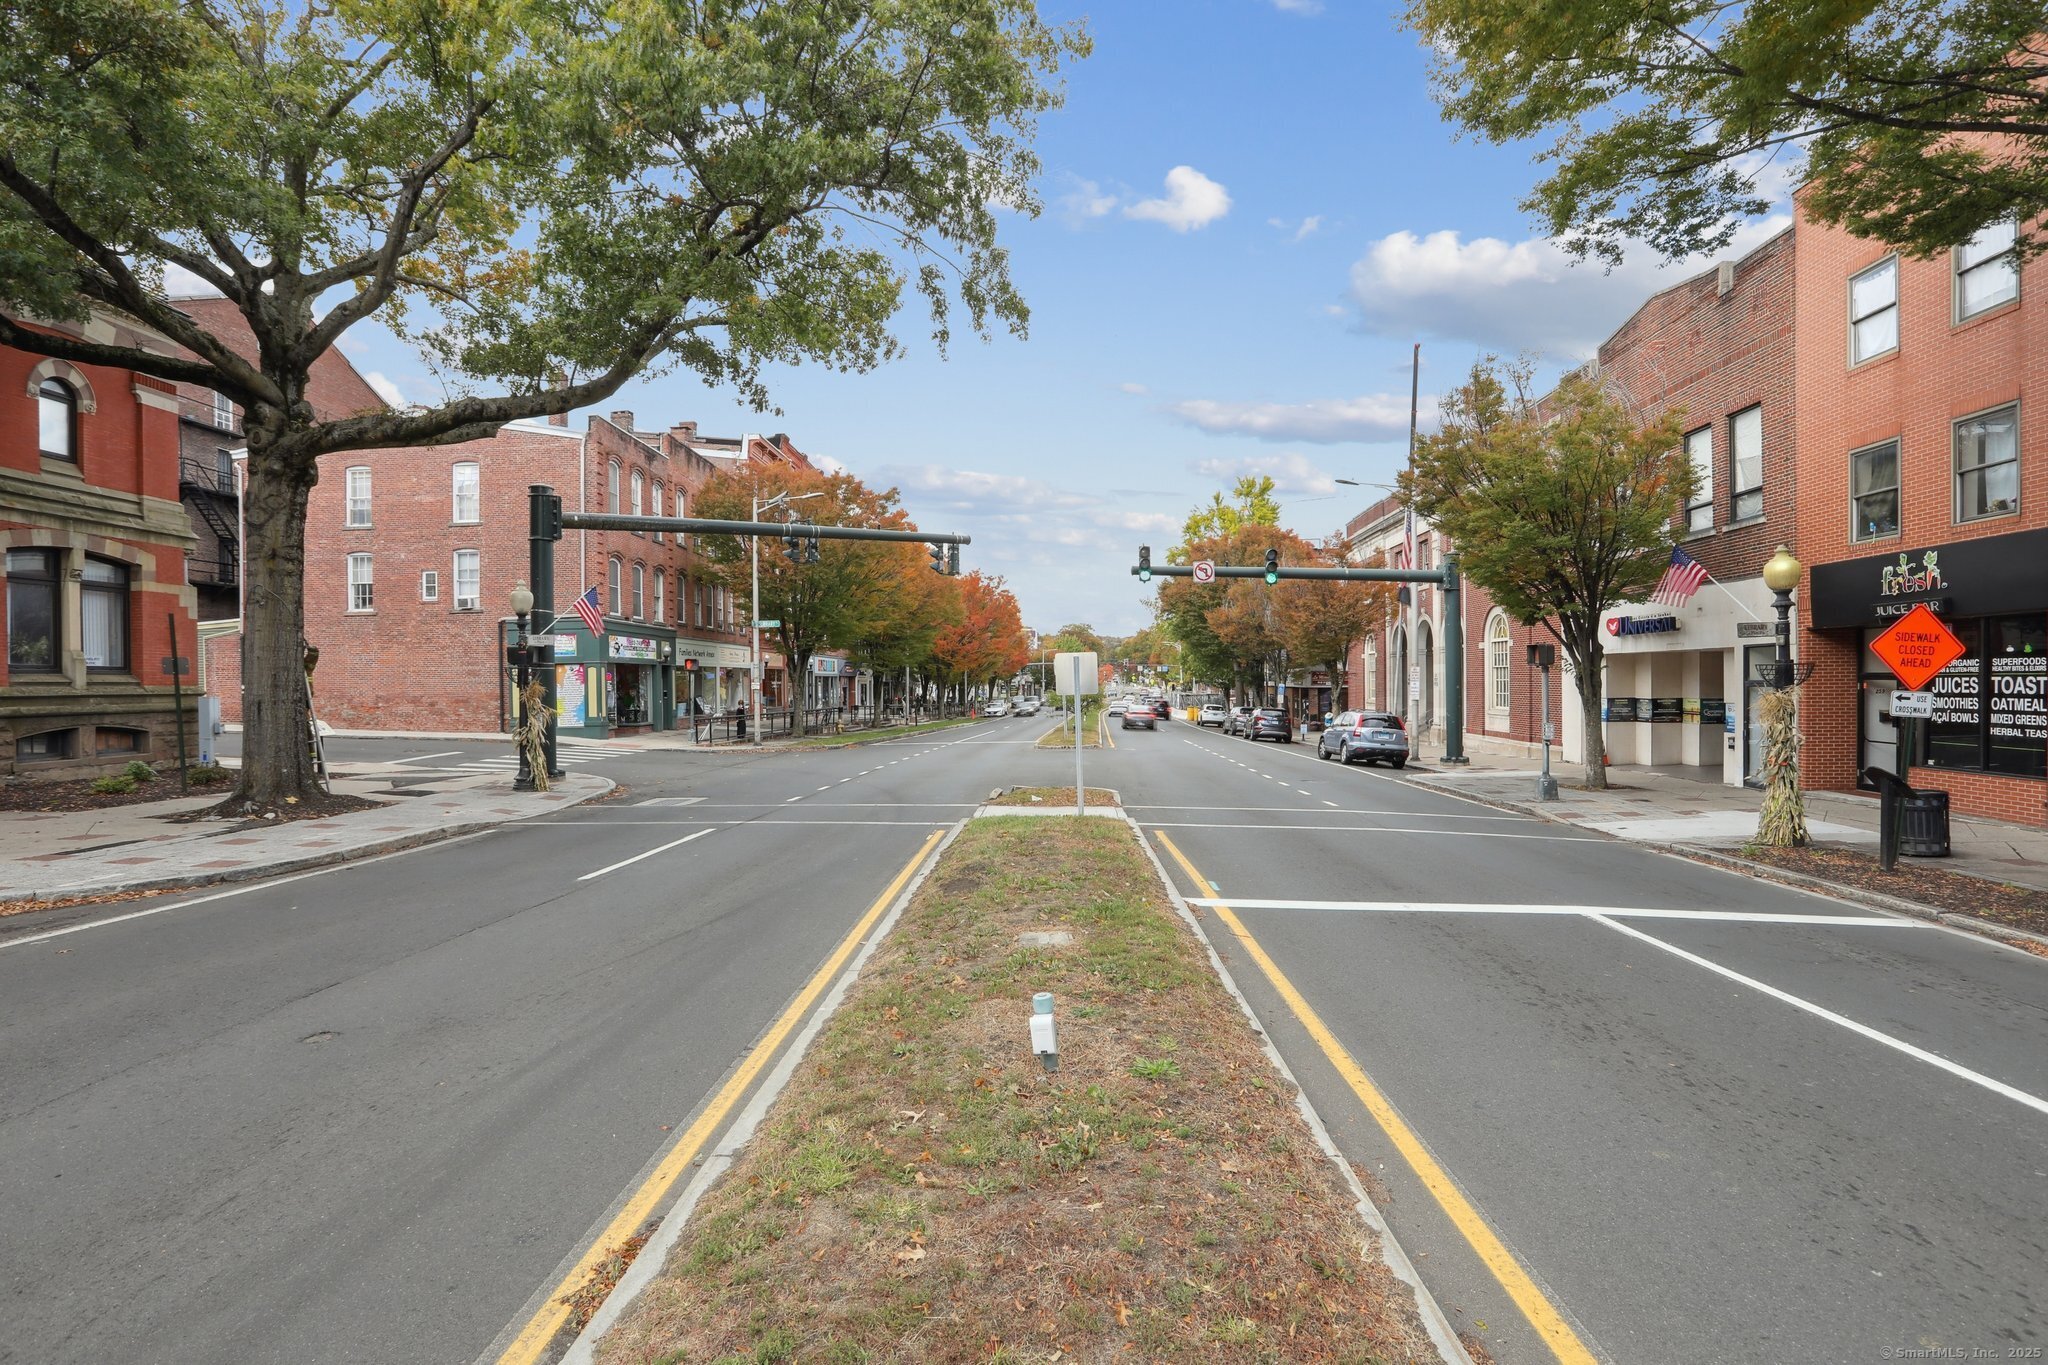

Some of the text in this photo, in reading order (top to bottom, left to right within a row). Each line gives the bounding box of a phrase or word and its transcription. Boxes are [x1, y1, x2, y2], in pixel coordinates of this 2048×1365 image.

[1875, 603, 1908, 617] JUICE
[1895, 632, 1940, 643] SIDEWALK
[1898, 645, 1935, 656] CLOSED
[1900, 658, 1931, 668] AHEAD
[1948, 658, 1980, 667] ORGANIC
[1992, 657, 2047, 666] SUPERFOODS
[1931, 677, 1979, 694] JUICES
[1991, 676, 2047, 695] TOAST
[1916, 695, 1928, 703] USE
[1932, 697, 1979, 710] SMOOTHIES
[1991, 697, 2047, 712] OATMEAL
[1895, 705, 1928, 714] CROSSWALK
[1931, 710, 1979, 724] AÇAÍ BOWLS
[1991, 713, 2047, 726] MIXED GREENS
[1990, 727, 2047, 739] HERBAL TEAS
